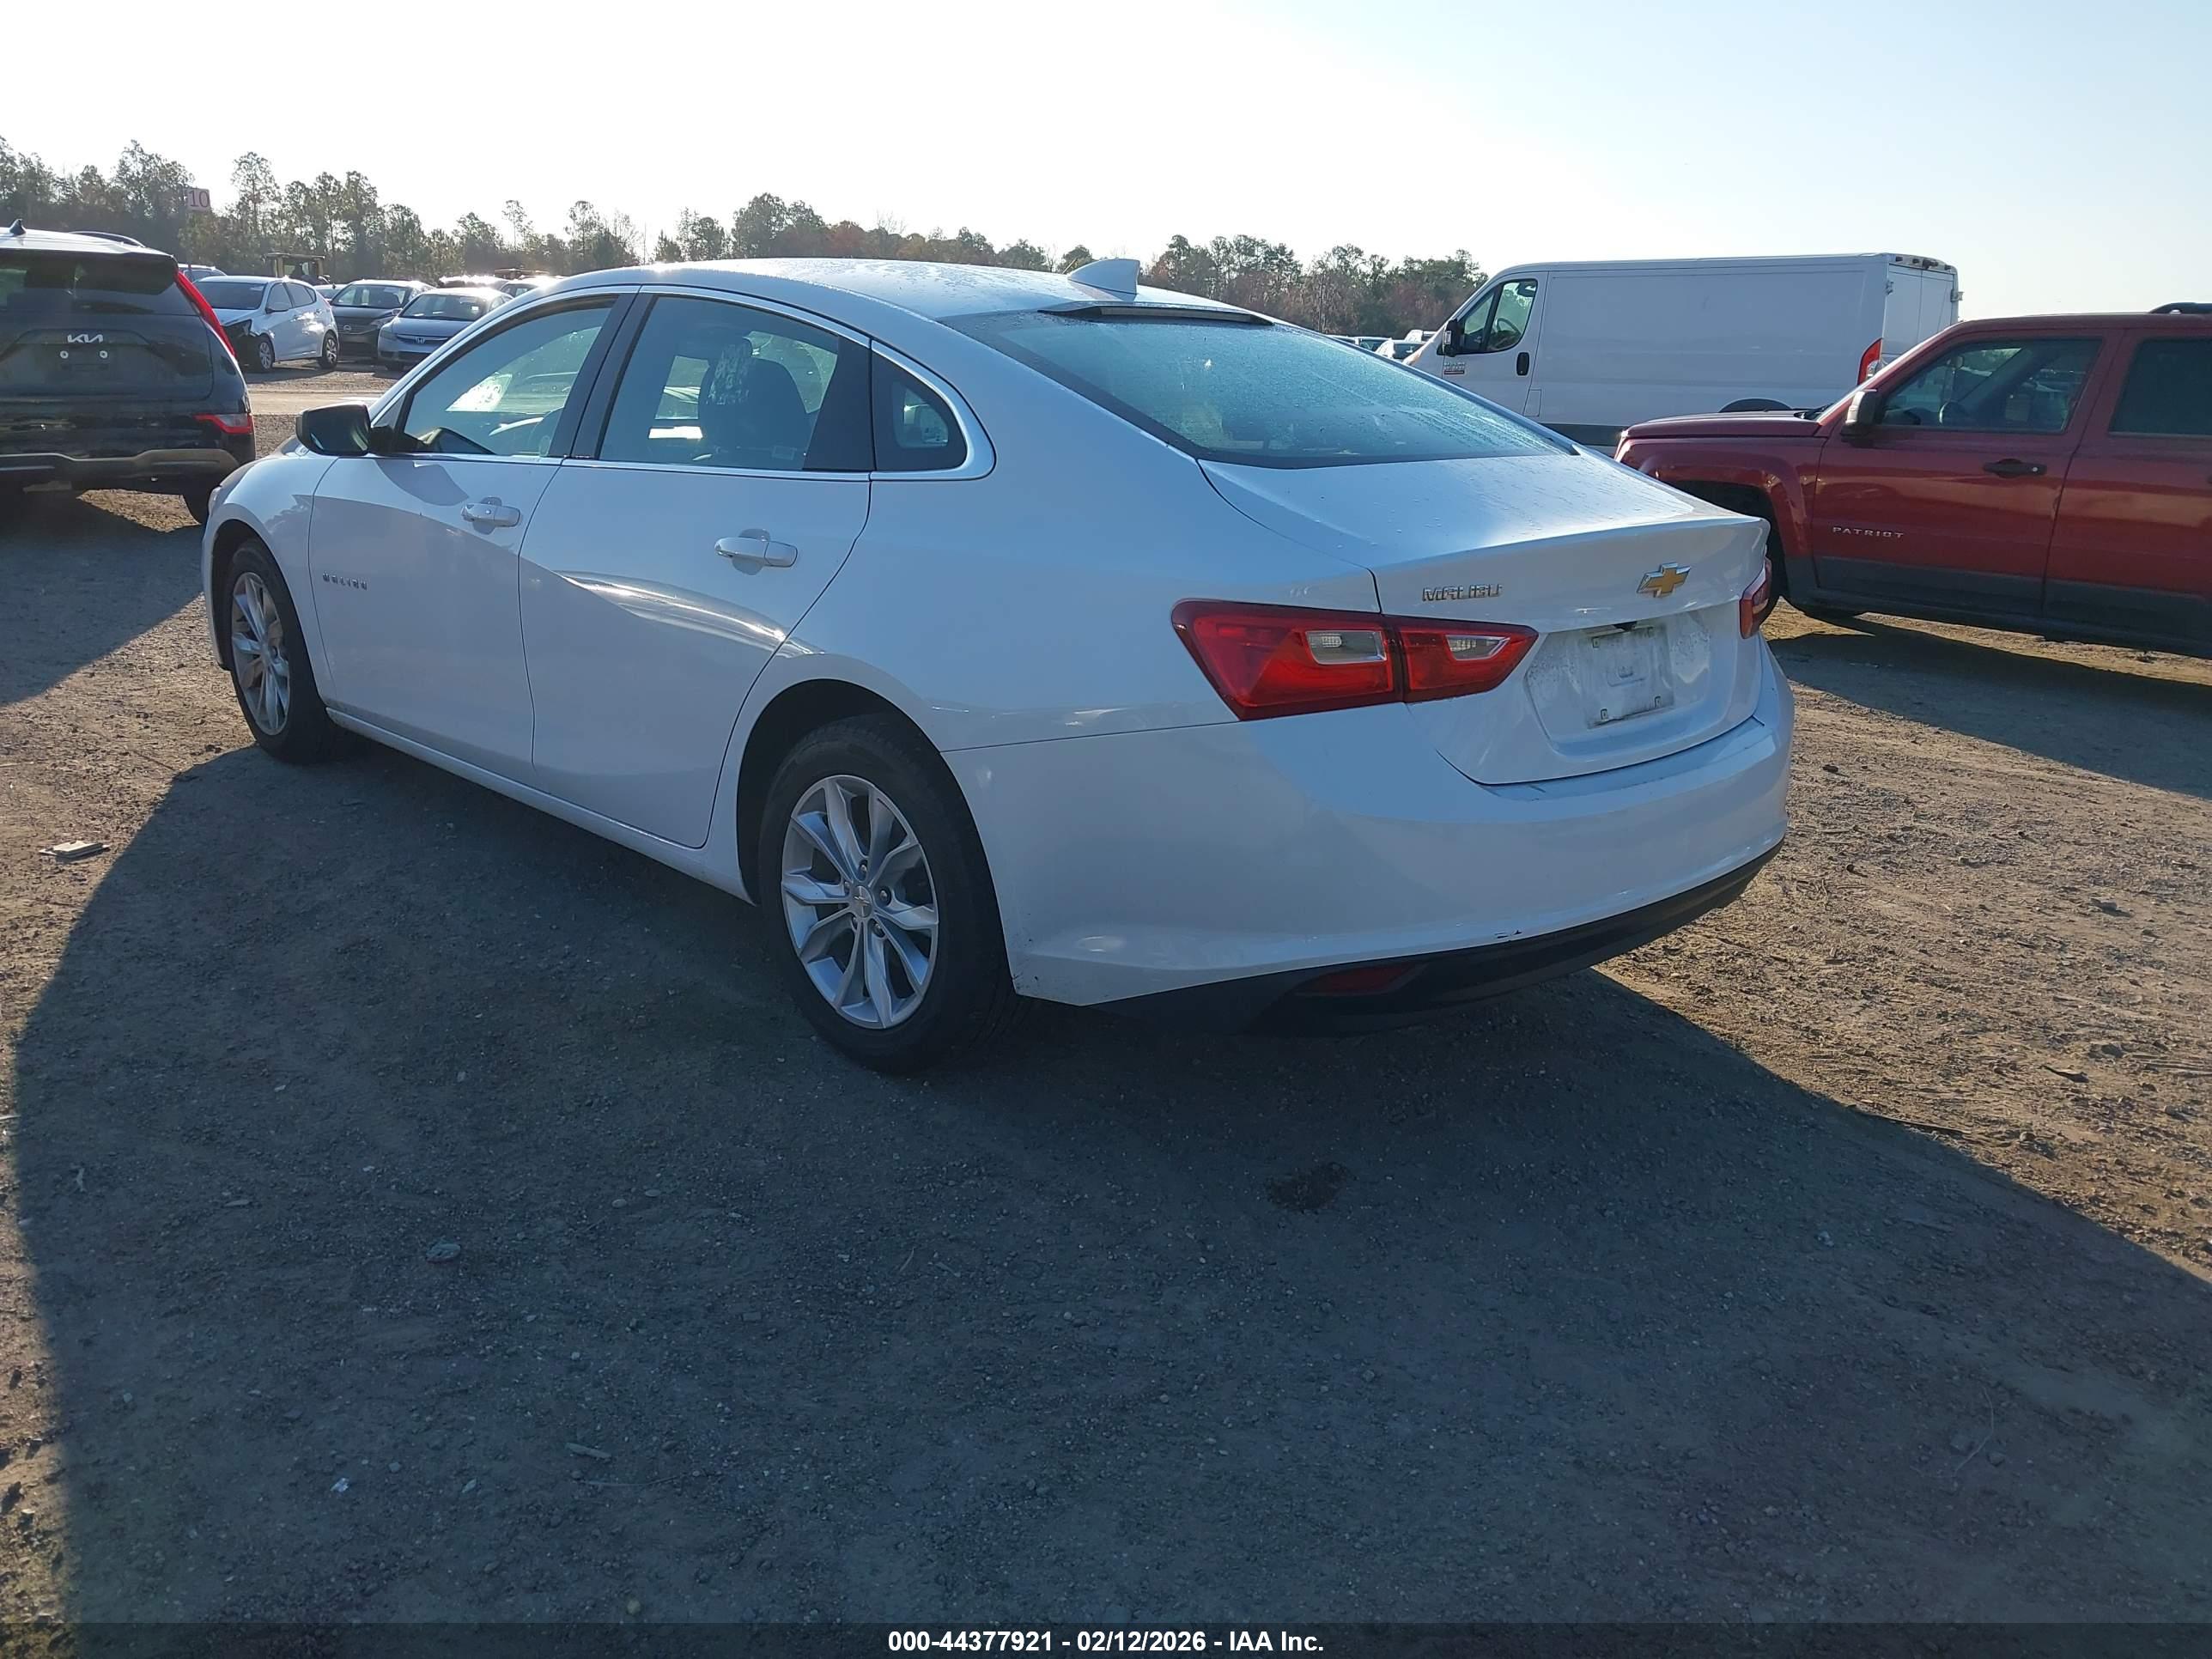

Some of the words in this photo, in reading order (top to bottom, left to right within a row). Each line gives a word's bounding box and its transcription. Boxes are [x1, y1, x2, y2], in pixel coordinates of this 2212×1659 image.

[189, 191, 210, 208] 10
[68, 334, 103, 343] KIA
[1832, 526, 1904, 538] PATRIOT
[1422, 584, 1503, 602] MALIBU
